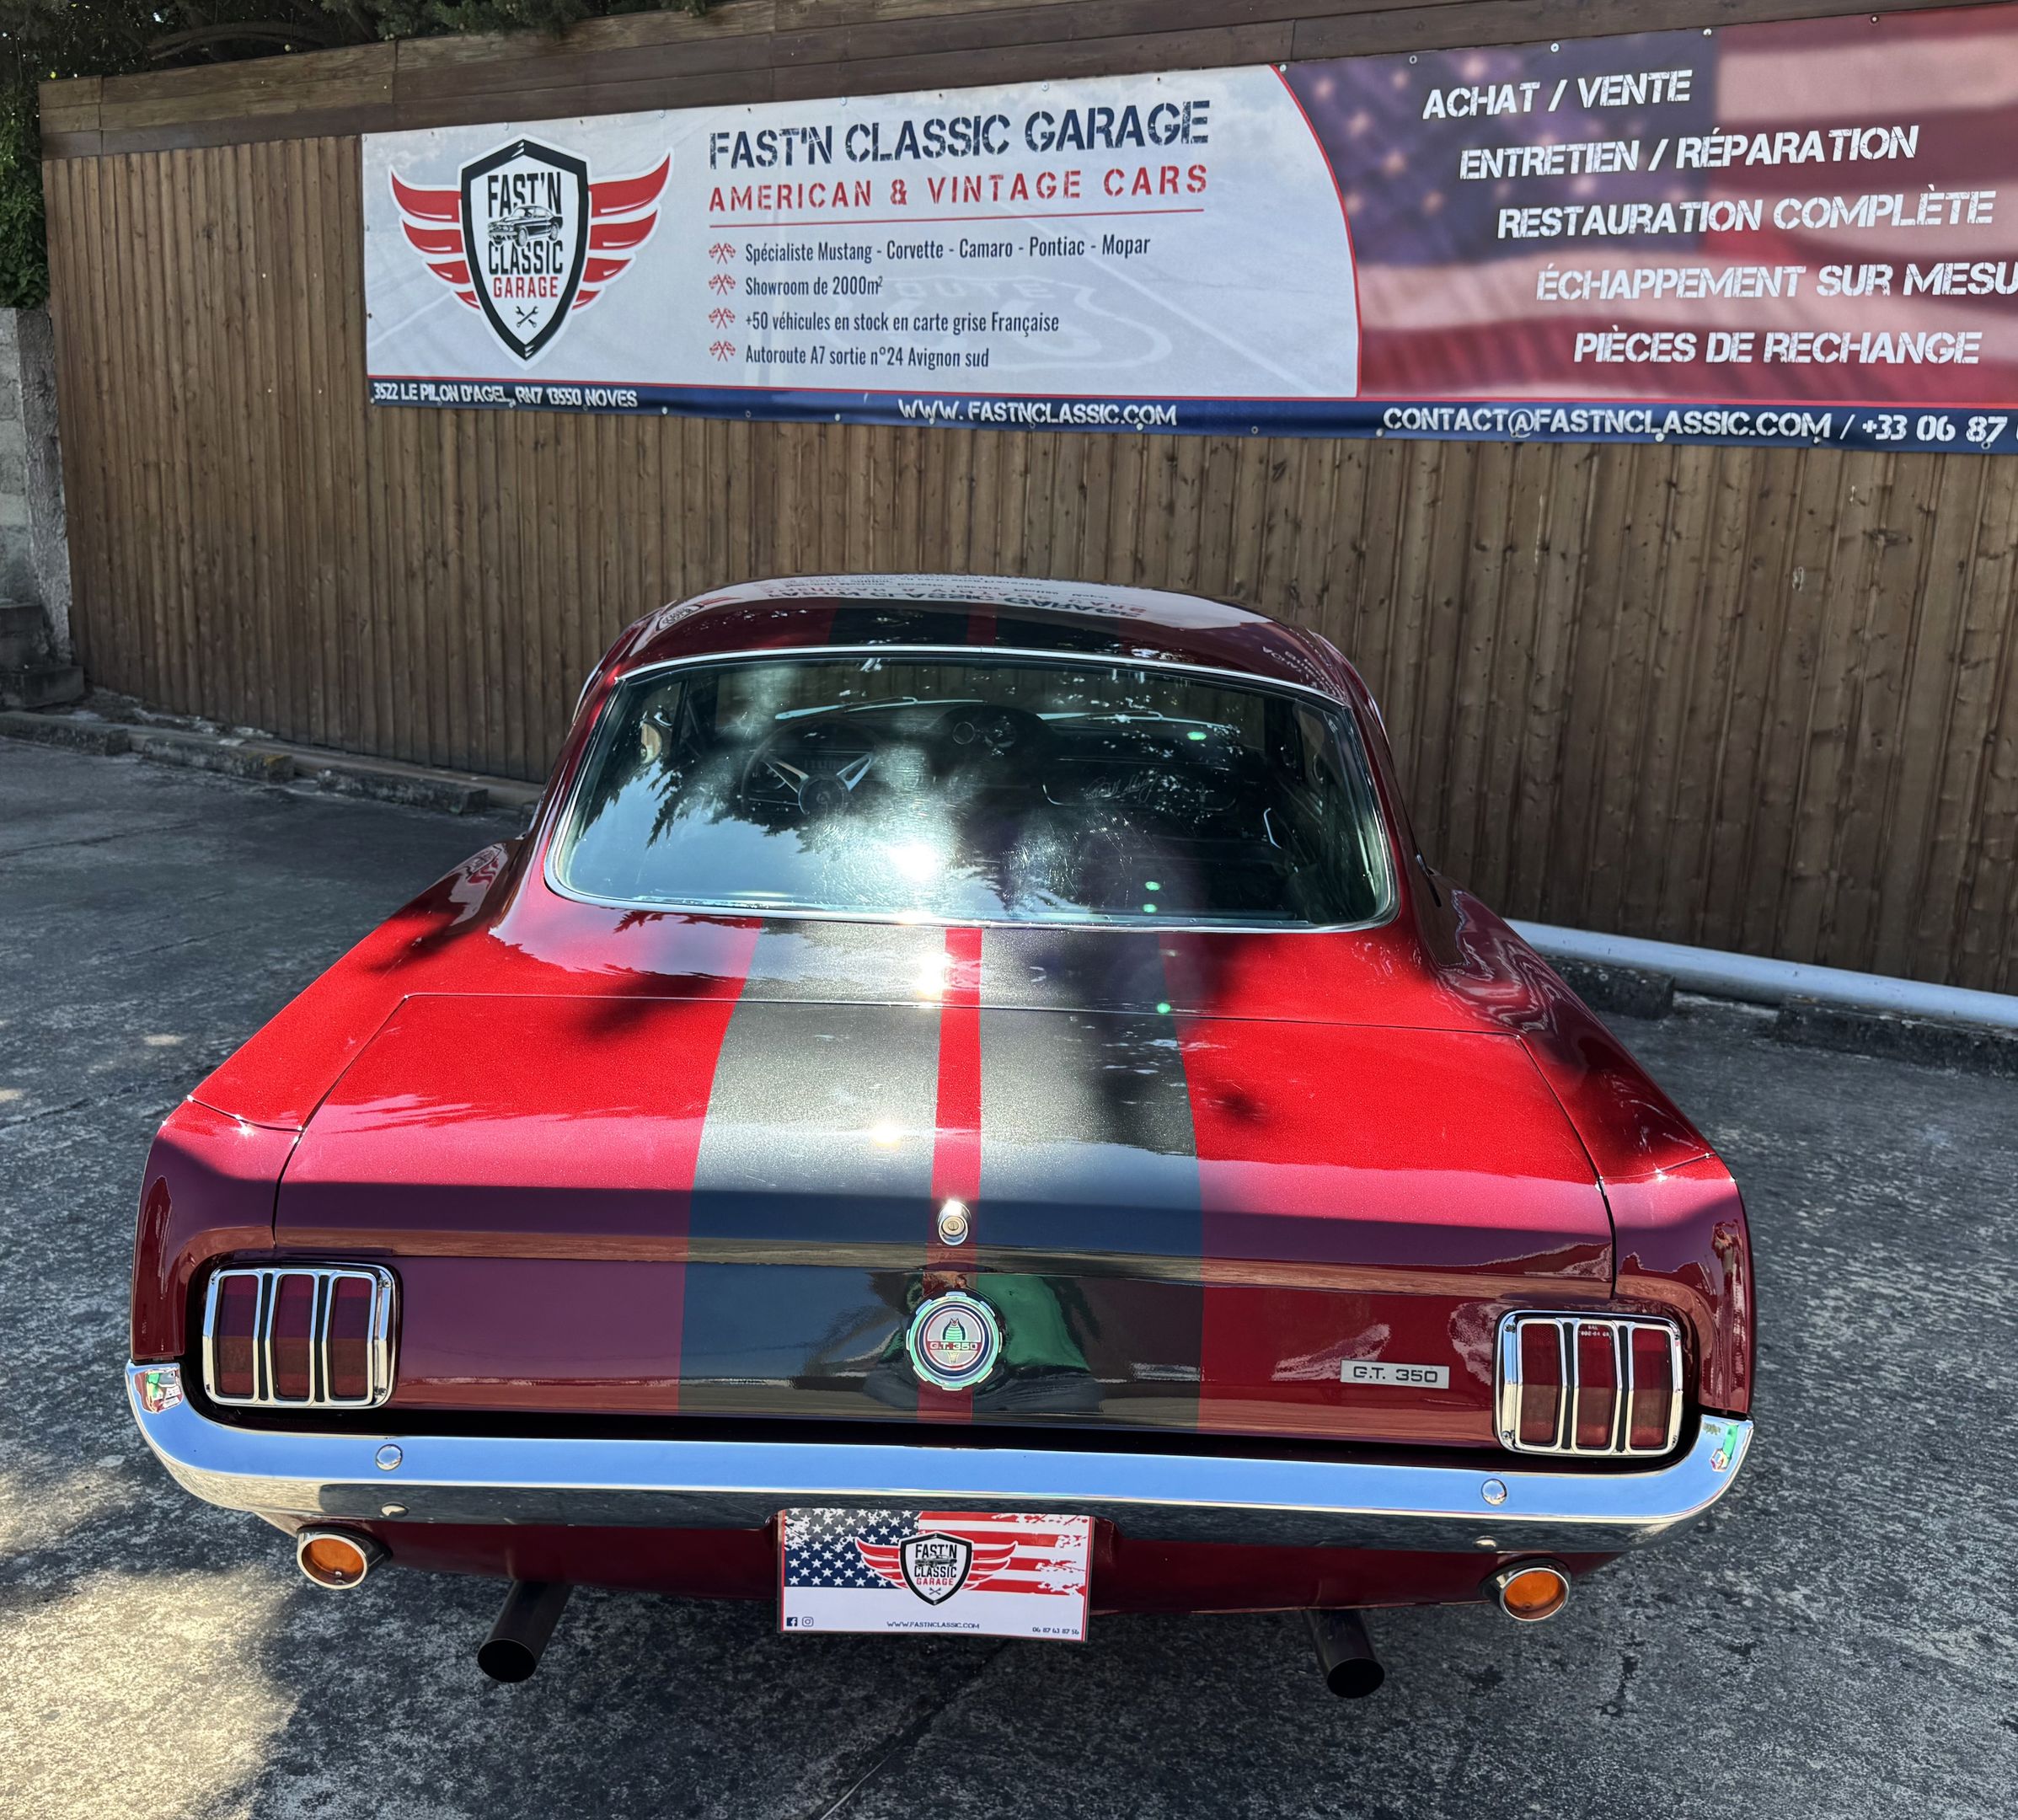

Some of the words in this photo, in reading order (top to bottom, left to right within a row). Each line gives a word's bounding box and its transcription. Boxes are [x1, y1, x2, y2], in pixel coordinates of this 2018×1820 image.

[1422, 81, 1541, 120] ACHAT
[1548, 78, 1568, 112] /
[1577, 69, 1693, 109] VENTE
[709, 125, 832, 170] FAST'N
[844, 114, 1011, 163] CLASSIC
[1025, 99, 1210, 153] GARAGE
[1459, 137, 1640, 183] ENTRETIEN
[1647, 138, 1669, 172] /
[1675, 125, 1919, 169] RÉPARATION
[487, 171, 562, 218] FAST'N
[709, 179, 871, 212] AMERICAN
[890, 179, 907, 206] &
[927, 169, 1081, 204] VINTAGE
[1103, 164, 1207, 196] CARS
[1497, 198, 1764, 239] RESTAURATION
[1773, 184, 1997, 230] COMPLÈTE
[488, 239, 564, 276] CLASSIC
[745, 242, 814, 265] Spécialiste
[817, 241, 873, 265] Mustang
[886, 239, 944, 260] Corvette
[959, 238, 1013, 259] Camaro
[1029, 236, 1085, 257] Pontiac
[1102, 233, 1151, 260] Mopar
[493, 276, 559, 298] GARAGE
[745, 276, 809, 296] Showroom
[813, 276, 828, 296] de
[1536, 262, 1807, 301] ÉCHAPPEMENT
[1812, 264, 1893, 299] SUR
[1903, 261, 2018, 296] MESU
[745, 311, 768, 330] +50
[772, 311, 831, 331] véhicules
[834, 316, 849, 331] en
[854, 311, 889, 331] stock
[892, 317, 908, 331] en
[913, 313, 949, 332] carte
[952, 312, 987, 336] grise
[991, 311, 1059, 338] Française
[745, 345, 806, 364] Autoroute
[810, 345, 826, 365] A7
[829, 346, 866, 366] sortie
[870, 346, 904, 367] n°24
[907, 346, 961, 371] Avignon
[965, 347, 989, 367] sud
[1574, 324, 1697, 363] PIÈCES
[1705, 331, 1756, 363] DE
[1763, 329, 1986, 364] RECHANGE
[373, 382, 399, 400] 3522
[400, 383, 419, 400] LE
[420, 383, 459, 402] PILON
[514, 385, 544, 404] RN7
[585, 388, 639, 408] NOVES
[1383, 407, 1833, 440] CONTACT@FASTNCLASSIC.COM
[1839, 414, 1856, 440] /
[1862, 414, 1908, 441] +33
[1916, 415, 1956, 442] 06
[1966, 415, 2008, 444] 87
[1353, 1366, 1386, 1380] G.T.
[1395, 1368, 1438, 1384] 350
[915, 1544, 957, 1559] FAST'N
[914, 1566, 957, 1578] CLASSIC
[916, 1577, 955, 1586] GARAGE
[886, 1621, 980, 1630] WWW.FASTNCLASSIC.COM
